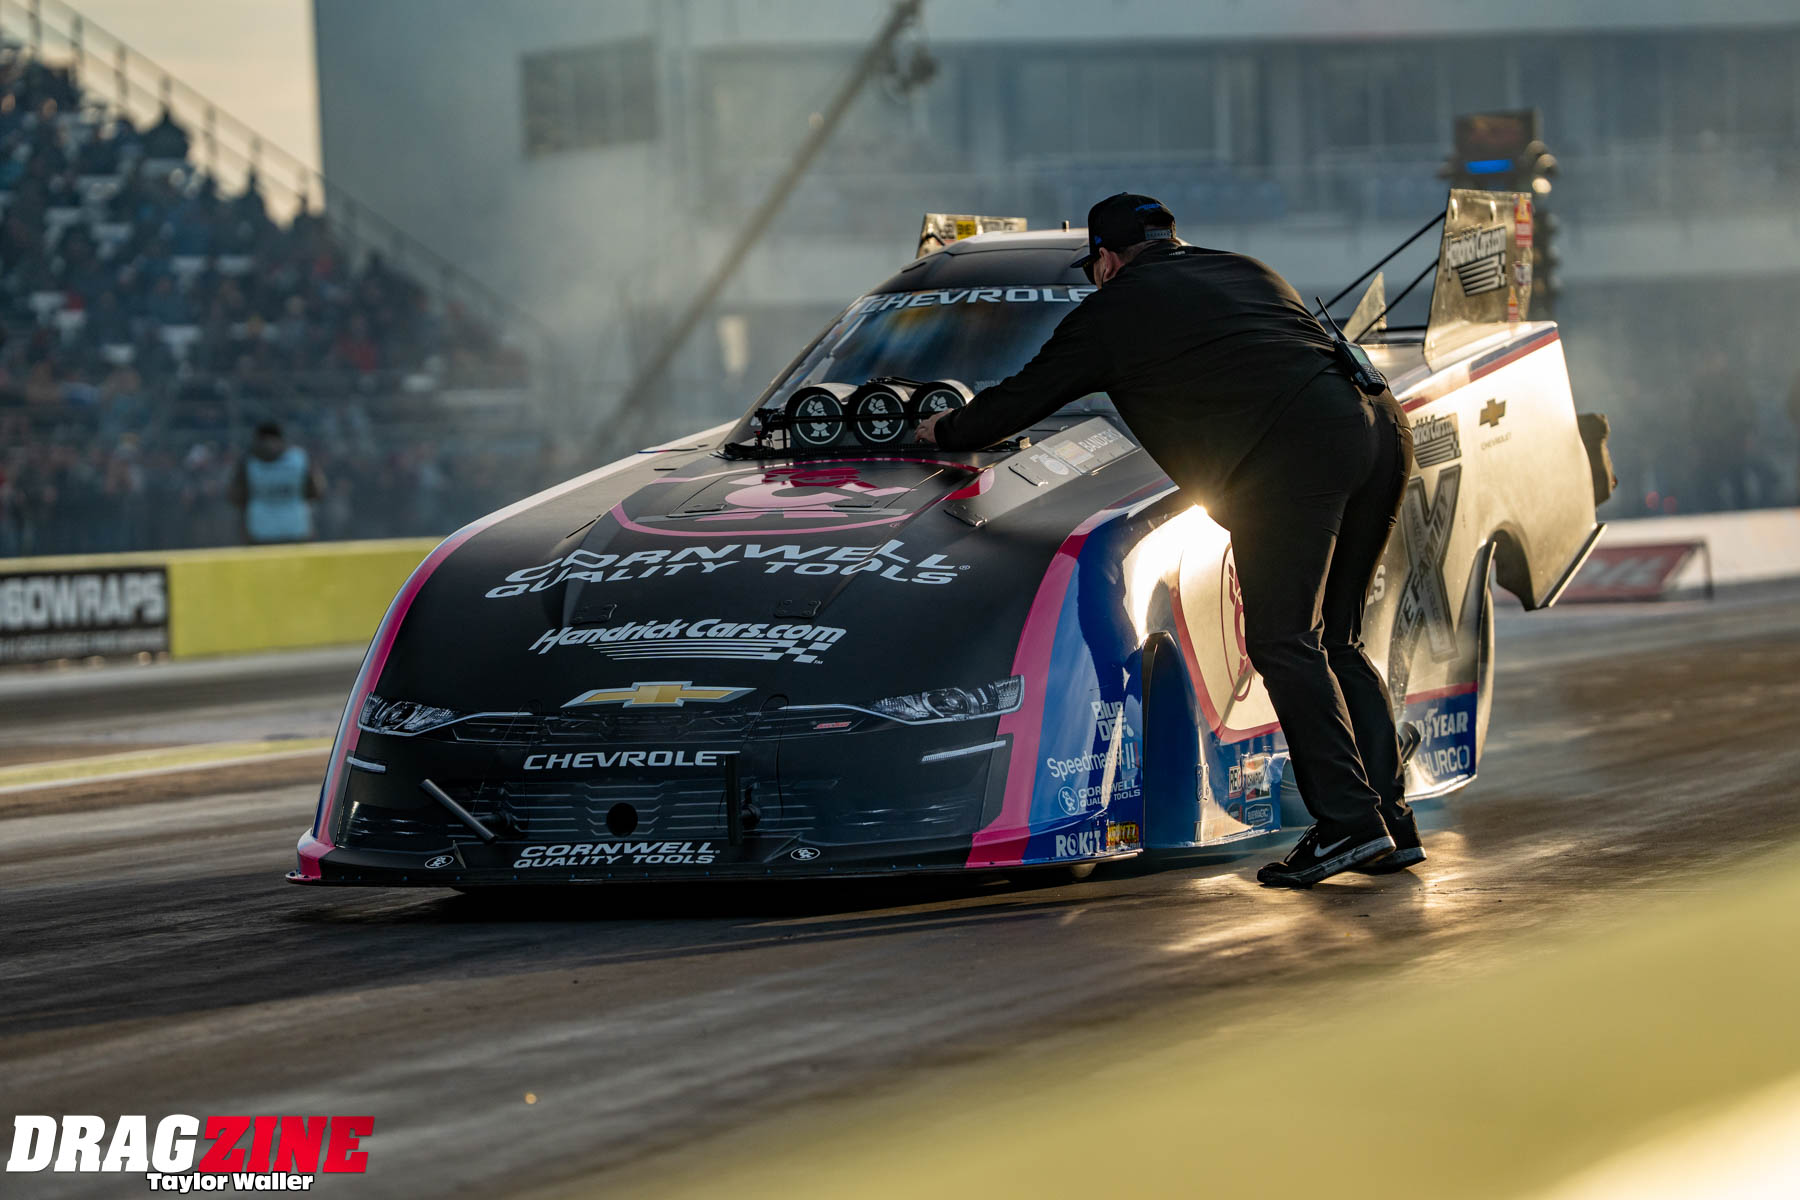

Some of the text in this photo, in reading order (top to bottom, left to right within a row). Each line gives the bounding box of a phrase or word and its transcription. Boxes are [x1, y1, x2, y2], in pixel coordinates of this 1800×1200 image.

[859, 287, 1098, 314] CHEVROLE
[505, 539, 955, 582] CORNWELL
[485, 558, 958, 598] QUALITY TOOLS
[1091, 700, 1124, 720] Blue
[1114, 789, 1141, 801] TOOLS
[520, 842, 715, 858] CORNWELL
[513, 855, 715, 869] QUALITY TOOLS
